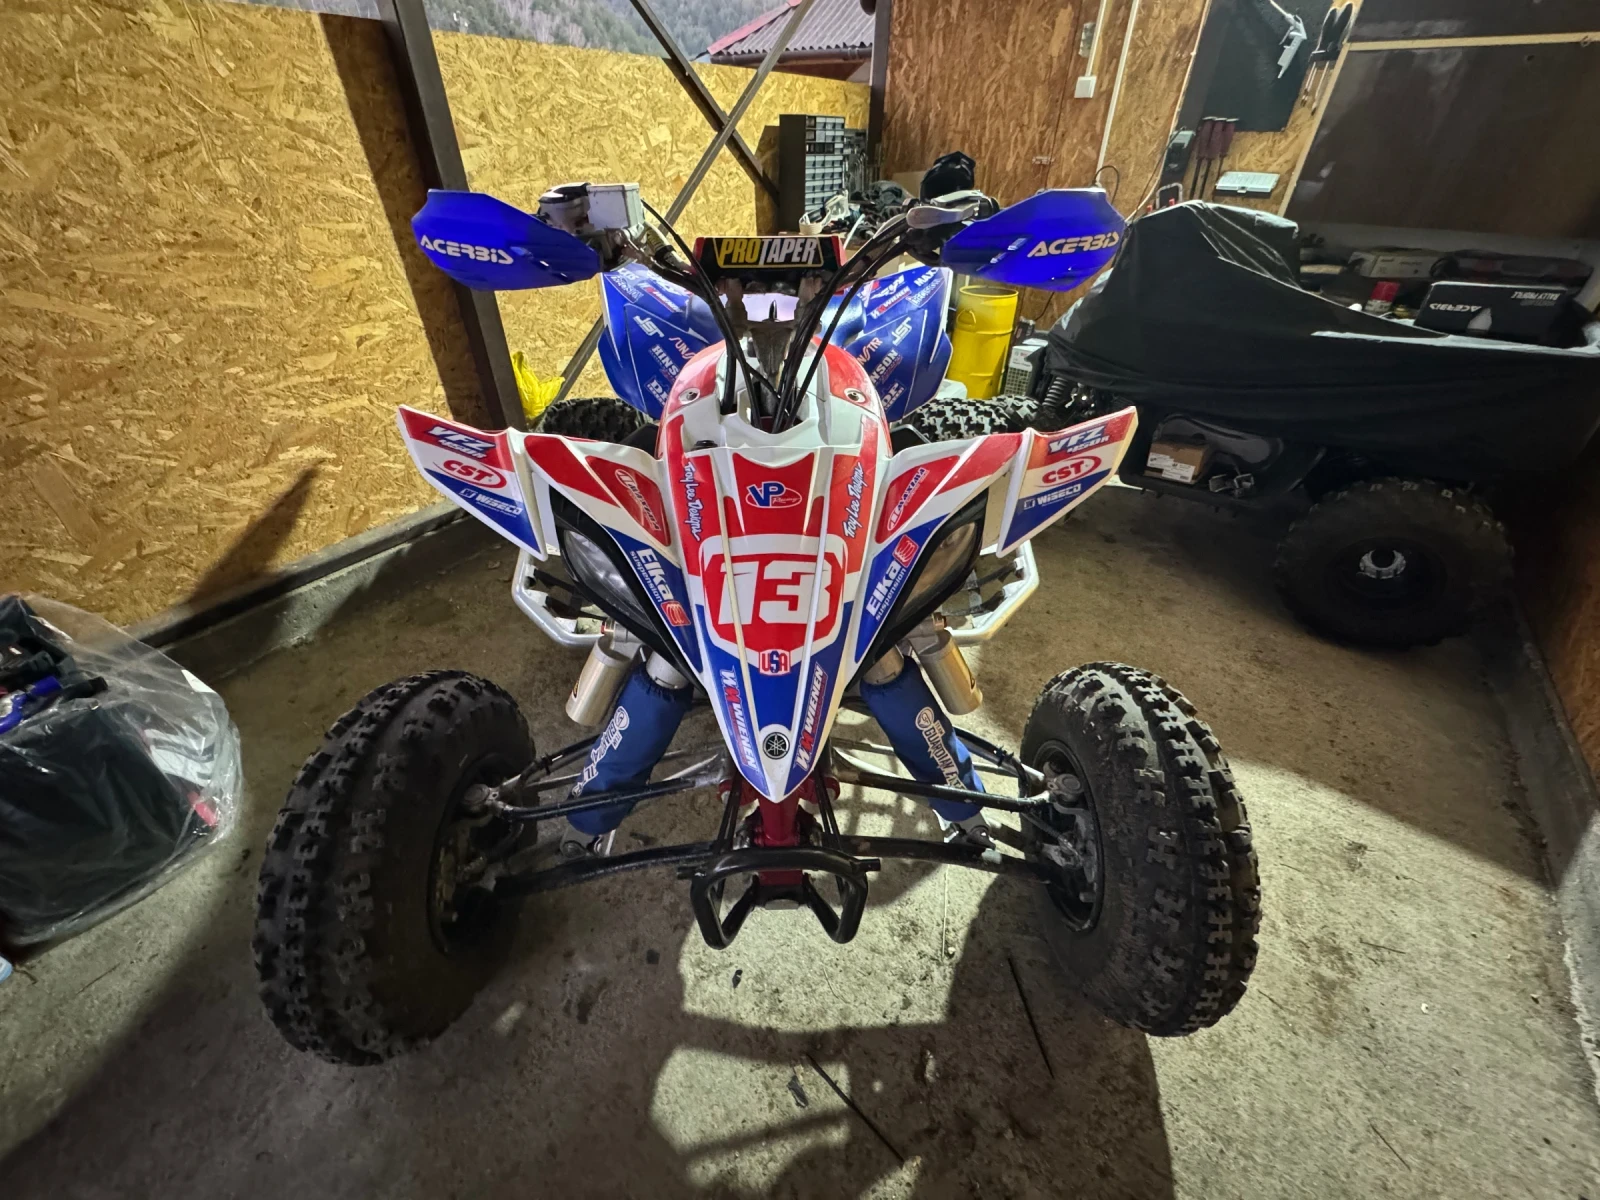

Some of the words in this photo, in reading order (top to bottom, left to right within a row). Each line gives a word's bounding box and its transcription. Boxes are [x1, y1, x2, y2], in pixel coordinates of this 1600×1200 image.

[720, 238, 818, 266] PROTAPER
[443, 459, 494, 482] CST
[680, 462, 696, 483] Troy
[847, 462, 867, 500] Designs
[1042, 460, 1085, 484] CST
[685, 481, 699, 500] Lee
[747, 481, 786, 508] VP
[897, 467, 927, 511] MAXIMA
[683, 498, 703, 541] Designs
[845, 497, 860, 519] Lee
[843, 514, 862, 538] Troy
[630, 550, 662, 603] suspension
[636, 549, 674, 600] Elka
[866, 559, 901, 617] Elka
[718, 560, 832, 625] 13
[875, 567, 907, 621] suspension
[761, 650, 788, 673] USA
[924, 726, 954, 769] GUARDIAN
